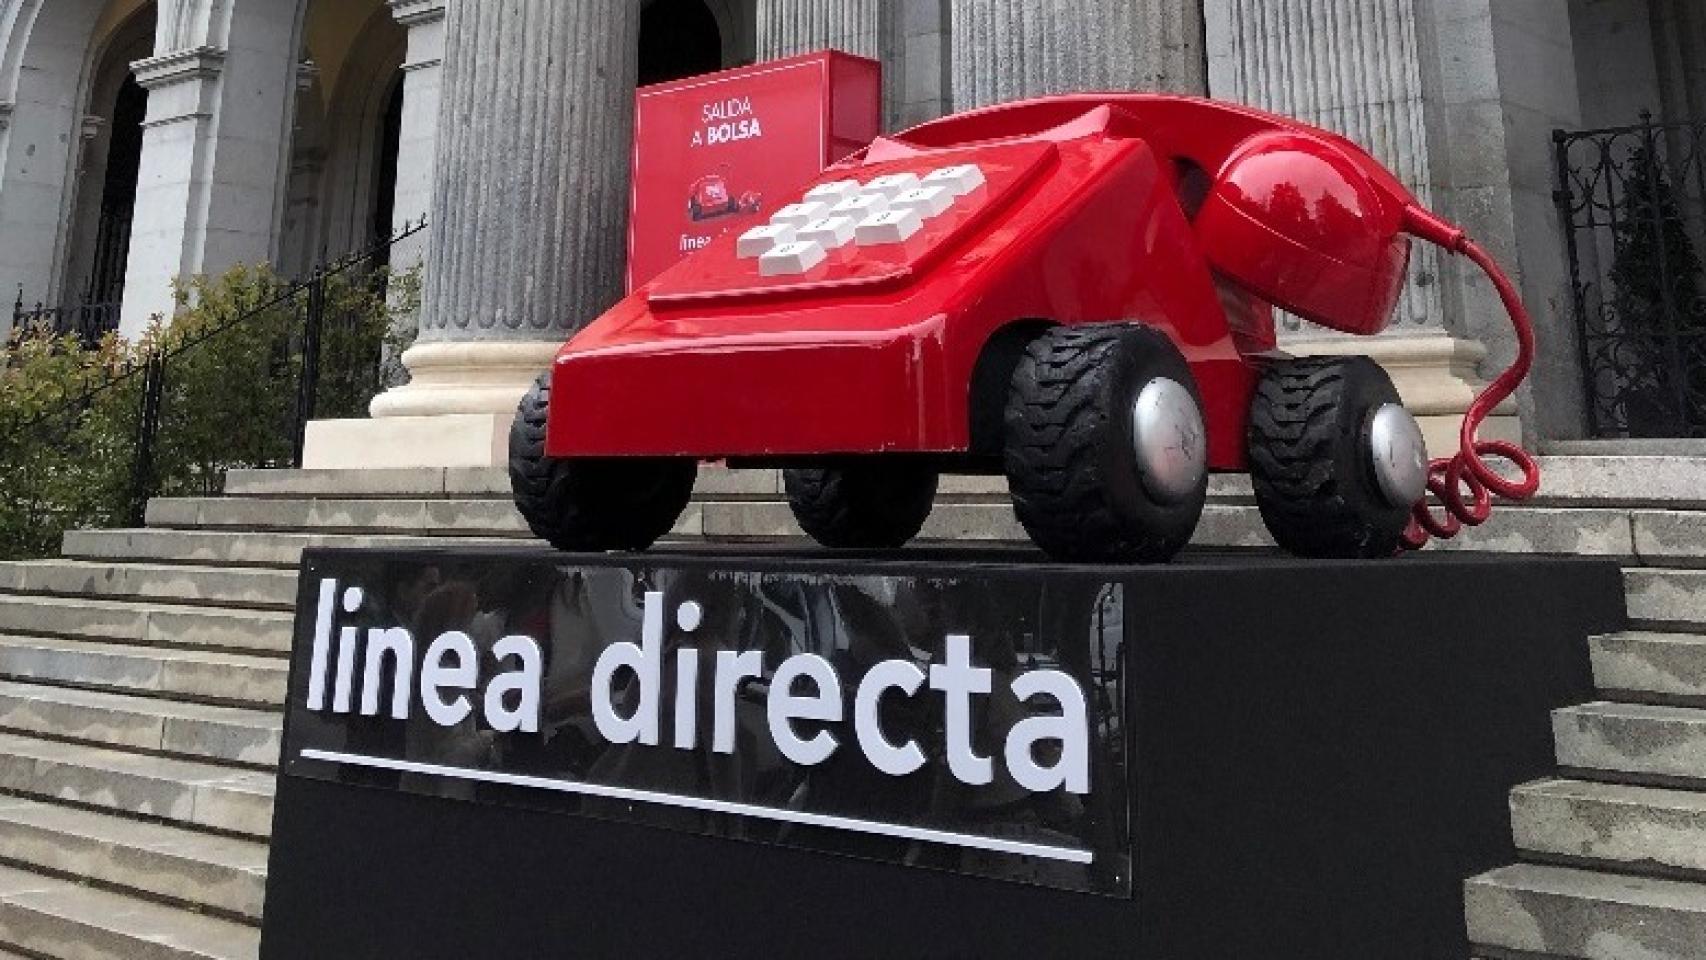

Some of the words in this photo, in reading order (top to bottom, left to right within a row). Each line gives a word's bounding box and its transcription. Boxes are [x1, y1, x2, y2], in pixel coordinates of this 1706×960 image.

[701, 96, 753, 123] SALIDA
[690, 131, 703, 147] A
[707, 118, 761, 145] BOLSA
[306, 577, 544, 734] linea
[591, 590, 1092, 794] directa
